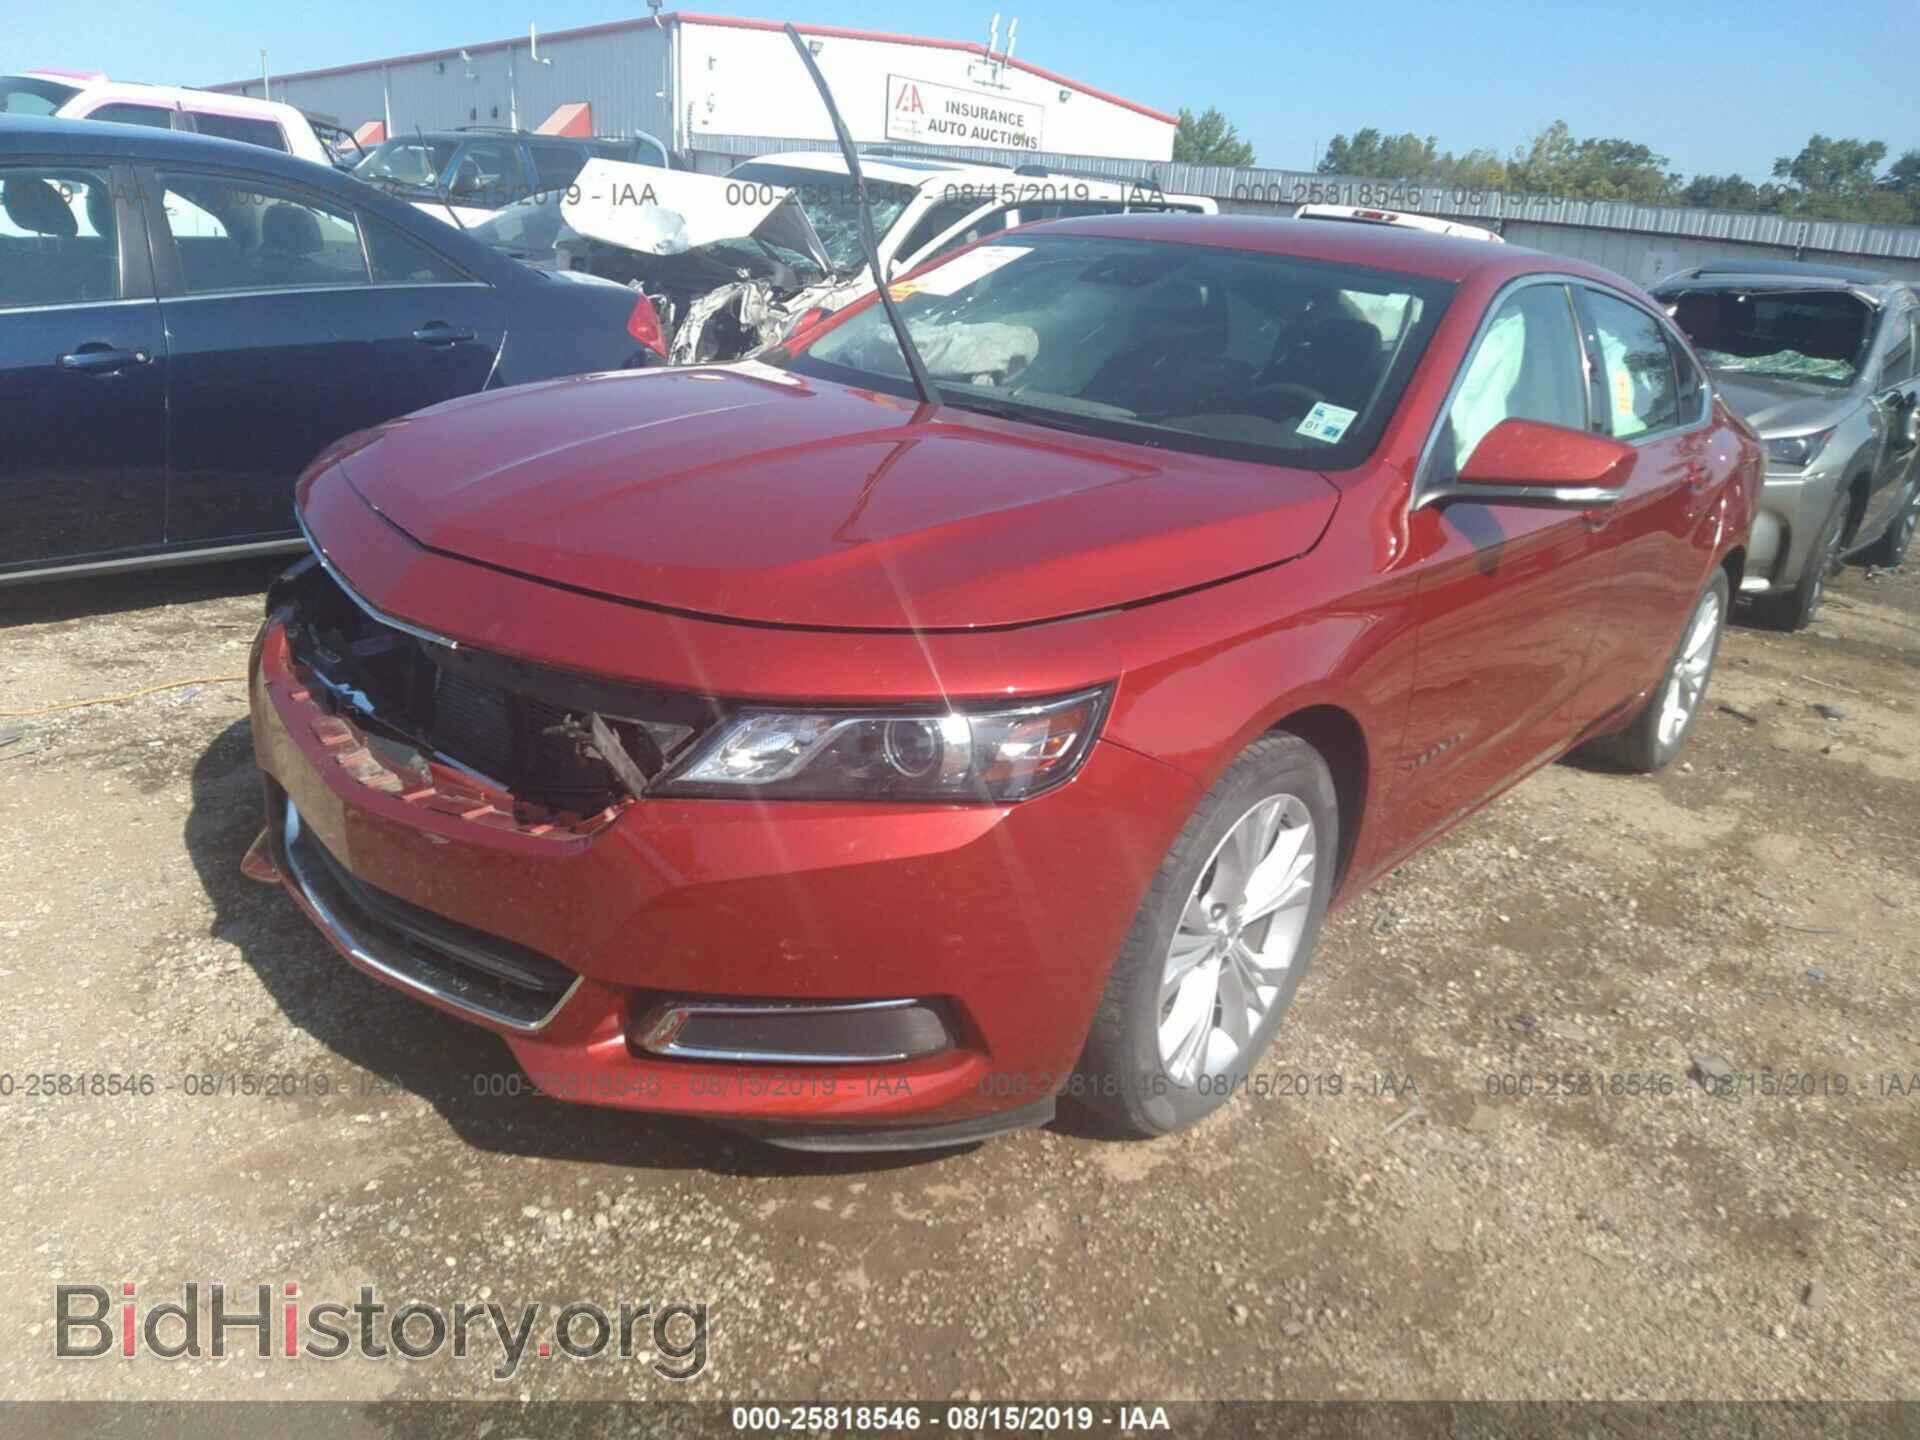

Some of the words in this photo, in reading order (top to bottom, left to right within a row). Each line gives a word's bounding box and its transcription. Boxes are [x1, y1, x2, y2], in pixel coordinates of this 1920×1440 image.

[945, 100, 1025, 127] INSURANCE
[928, 118, 967, 137] AUTO
[970, 126, 1038, 150] AUCTIONS
